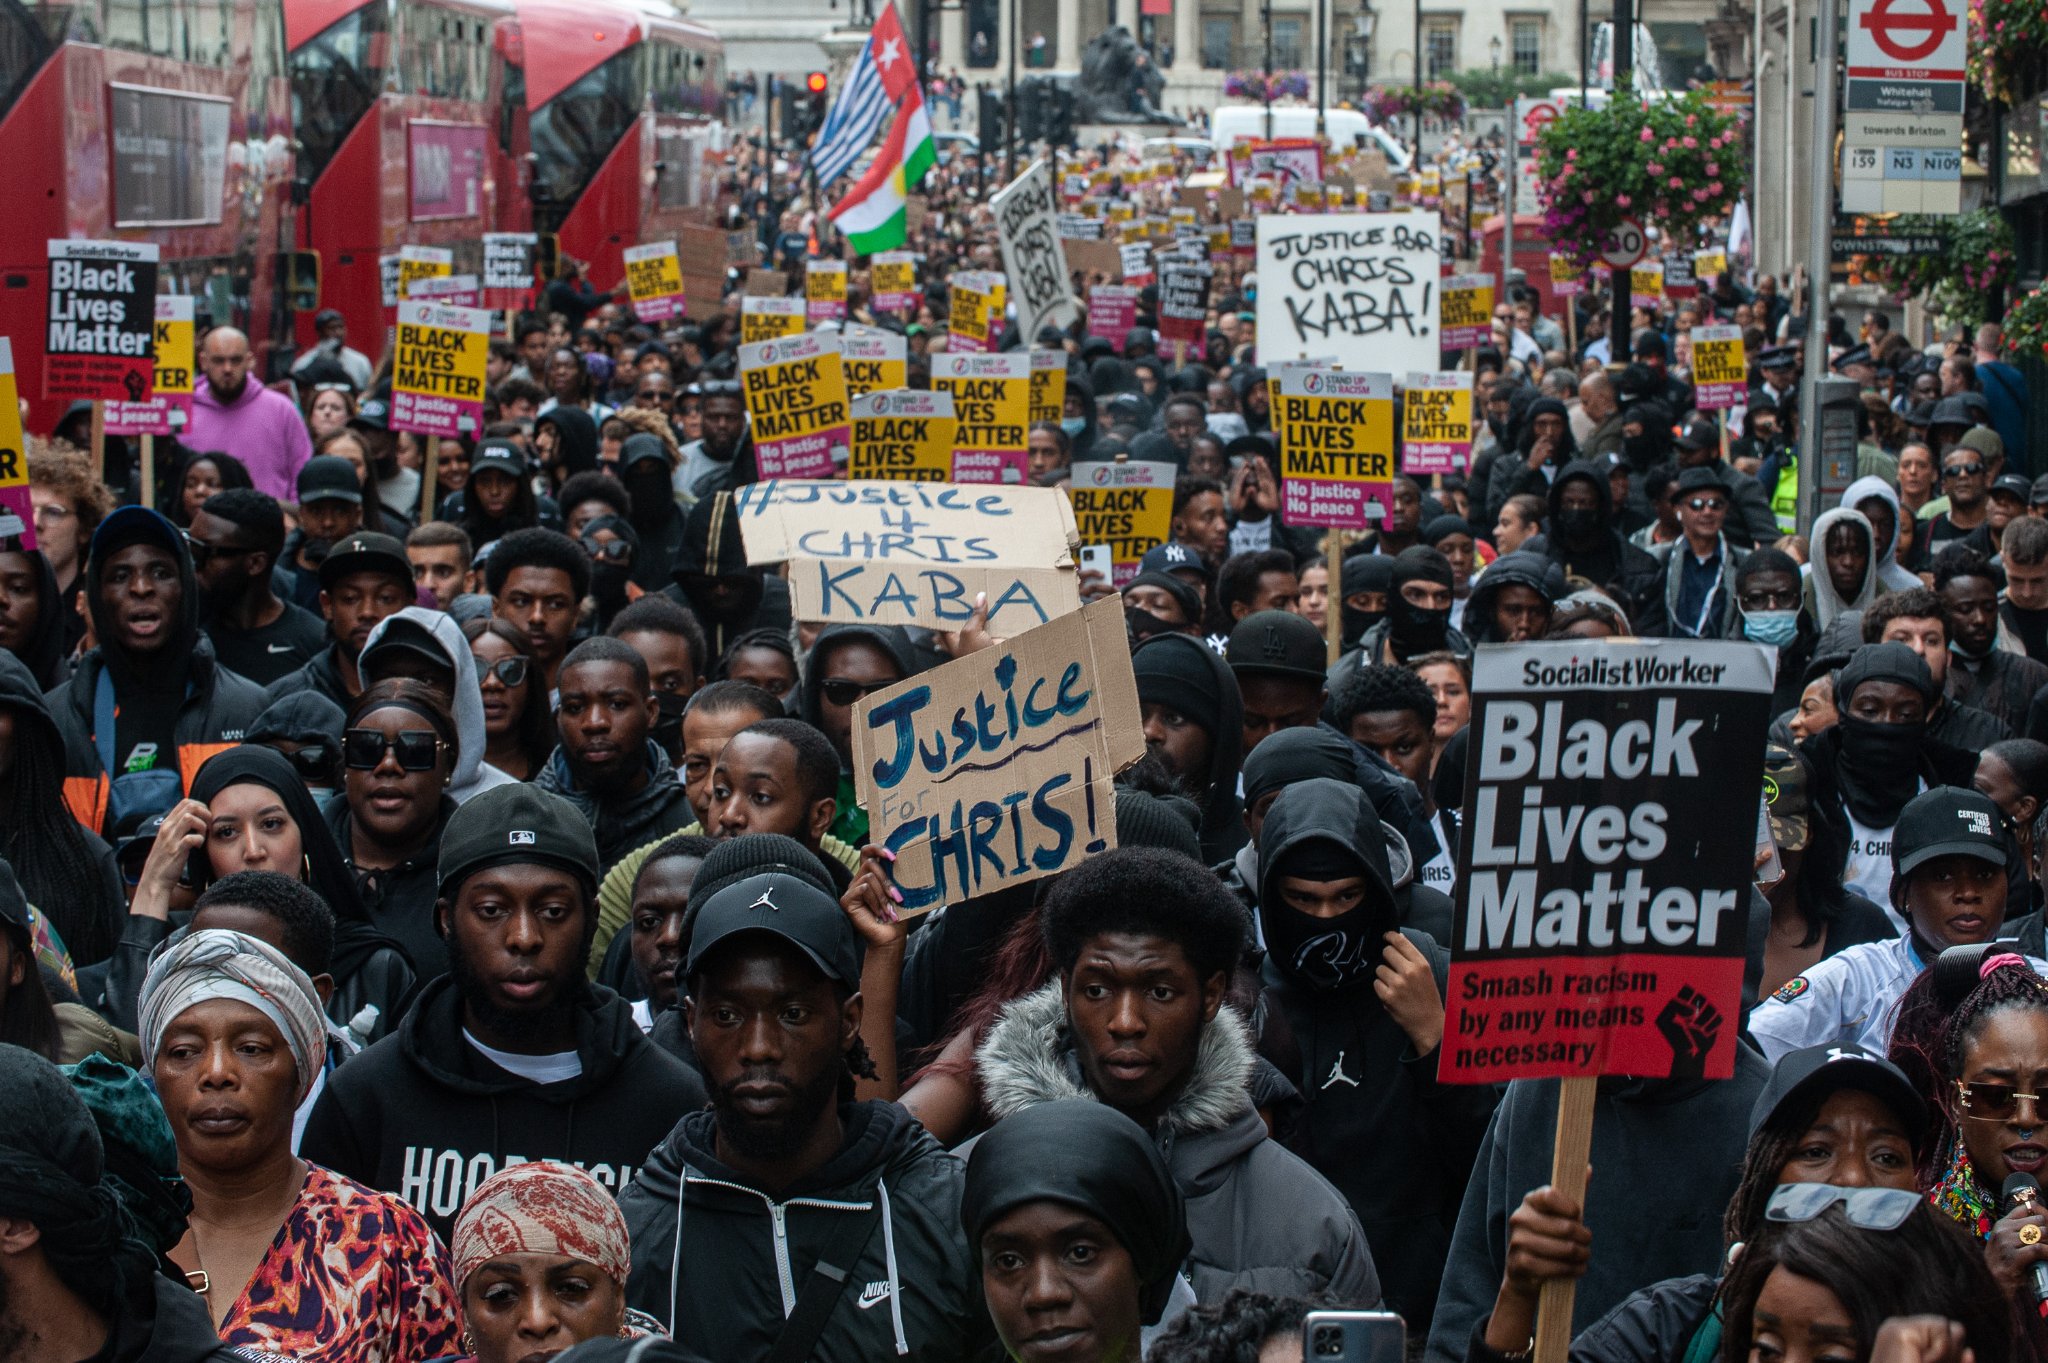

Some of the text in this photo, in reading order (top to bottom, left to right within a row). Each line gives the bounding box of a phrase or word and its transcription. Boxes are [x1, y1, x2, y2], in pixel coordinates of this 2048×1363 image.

[1906, 70, 1930, 79] STOP
[1881, 86, 1932, 98] Whitehall
[1863, 126, 1946, 136] towards Brixton
[1852, 157, 1876, 168] 159
[1893, 158, 1913, 169] N3
[1924, 159, 1959, 170] N109
[1269, 228, 1385, 260] JUSTICE
[51, 260, 135, 293] Black
[1293, 257, 1414, 290] CHRIS
[50, 291, 126, 323] Lives
[1284, 282, 1431, 342] KABA!
[745, 314, 788, 328] BLACK
[50, 322, 151, 355] Matter
[401, 326, 466, 351] BLACK
[400, 348, 455, 371] LIVES
[398, 369, 480, 397] MATTER
[747, 360, 820, 392] BLACK
[844, 362, 882, 382] ACK
[1325, 376, 1366, 385] STAND UP
[1326, 384, 1370, 394] TO RACISM
[1408, 390, 1455, 406] BLACK
[395, 393, 458, 415] No justice
[751, 386, 814, 415] LIVES
[904, 404, 934, 413] RACISM
[1287, 398, 1367, 425] BLACK
[413, 411, 451, 426] peace
[755, 401, 845, 438] MATTER
[1408, 407, 1448, 423] LIVES
[856, 420, 928, 442] BLACK
[954, 425, 1023, 446] ATTER
[1287, 424, 1354, 450] LIVES
[1407, 424, 1468, 439] MATTER
[759, 435, 828, 459] No justice
[854, 444, 915, 466] LIVES
[762, 453, 825, 475] No peace
[954, 451, 1001, 468] justice
[1287, 450, 1388, 477] MATTER
[954, 467, 995, 483] peace
[1124, 475, 1153, 484] RACISM
[1075, 490, 1147, 511] BLACK
[1287, 480, 1361, 502] No justice
[1287, 497, 1355, 518] No peace
[881, 508, 930, 533] 4
[799, 530, 999, 563] CHRIS
[819, 560, 1050, 624] KABA
[868, 653, 1093, 790] Justice
[1479, 698, 1704, 782] Black
[882, 757, 1108, 910] CHRIS!
[1471, 785, 1669, 866] Lives
[1851, 840, 1860, 854] 4
[1464, 868, 1738, 952] Matter
[1462, 967, 1658, 1001] Smash racism
[1458, 1003, 1645, 1041] by any means
[1455, 1038, 1597, 1070] necessary
